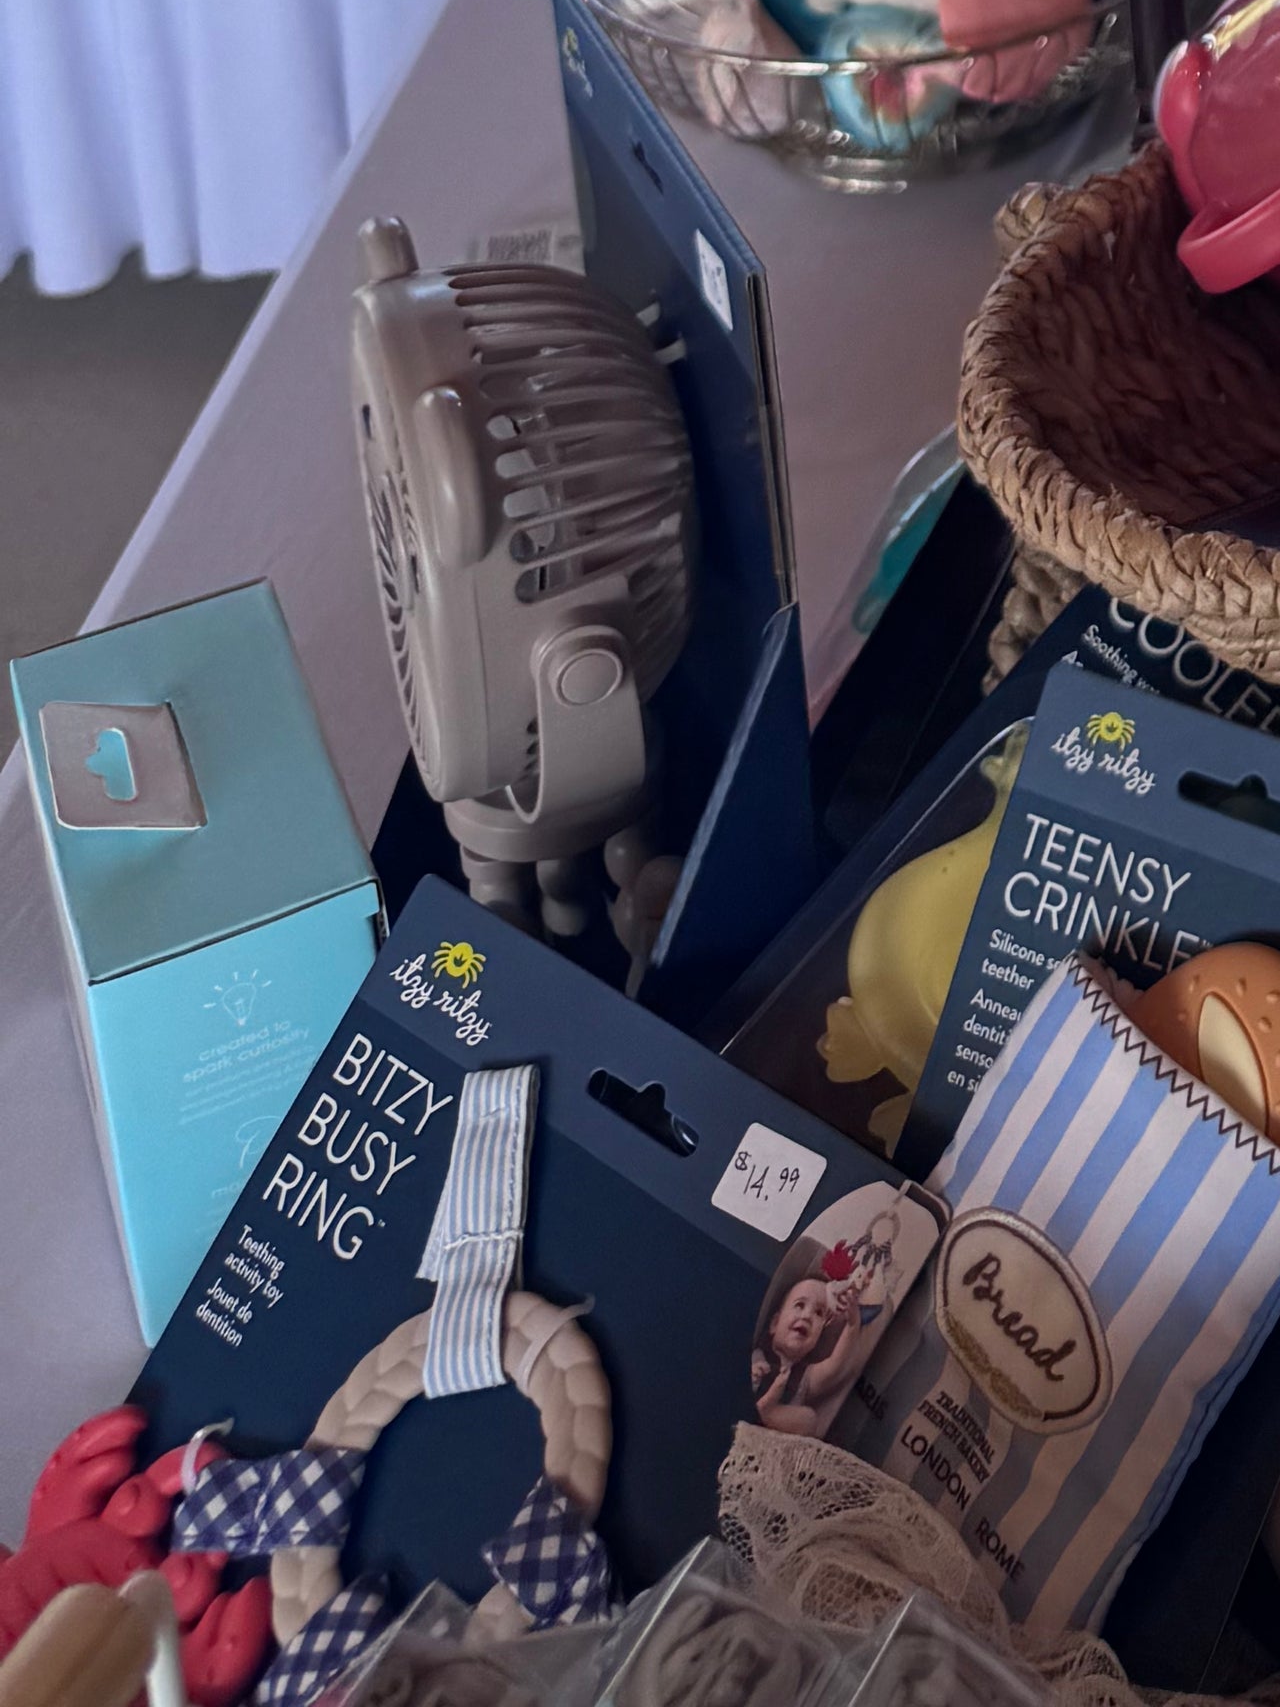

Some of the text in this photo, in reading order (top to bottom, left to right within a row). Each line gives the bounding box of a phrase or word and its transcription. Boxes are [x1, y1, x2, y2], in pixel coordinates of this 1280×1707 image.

[1083, 624, 1138, 684] Soothing
[1051, 726, 1156, 796] itzy ritzy
[1026, 813, 1192, 913] TEENSY
[981, 957, 1034, 990] teether
[989, 928, 1045, 967] Silicone
[390, 953, 492, 1046] itzy ritzy
[183, 1026, 311, 1083] spark curiosity
[199, 1019, 292, 1062] created to
[955, 1043, 994, 1069] senso
[964, 1014, 1013, 1045] dentit
[332, 1033, 454, 1136] BITZY
[947, 1069, 965, 1086] en
[298, 1093, 417, 1195] BUSY
[734, 1151, 801, 1201] $14.99
[224, 1252, 285, 1309] activity toy
[238, 1224, 285, 1280] Teething
[196, 1299, 243, 1347] dentition
[207, 1277, 253, 1324] Jouet de
[963, 1252, 1077, 1382] Bread
[852, 1374, 889, 1421] ARIS
[917, 1399, 991, 1485] FRENCH BAKERY
[935, 1390, 996, 1464] TRADITIONAL
[900, 1425, 972, 1512] LONDON
[975, 1516, 1026, 1581] ROME
